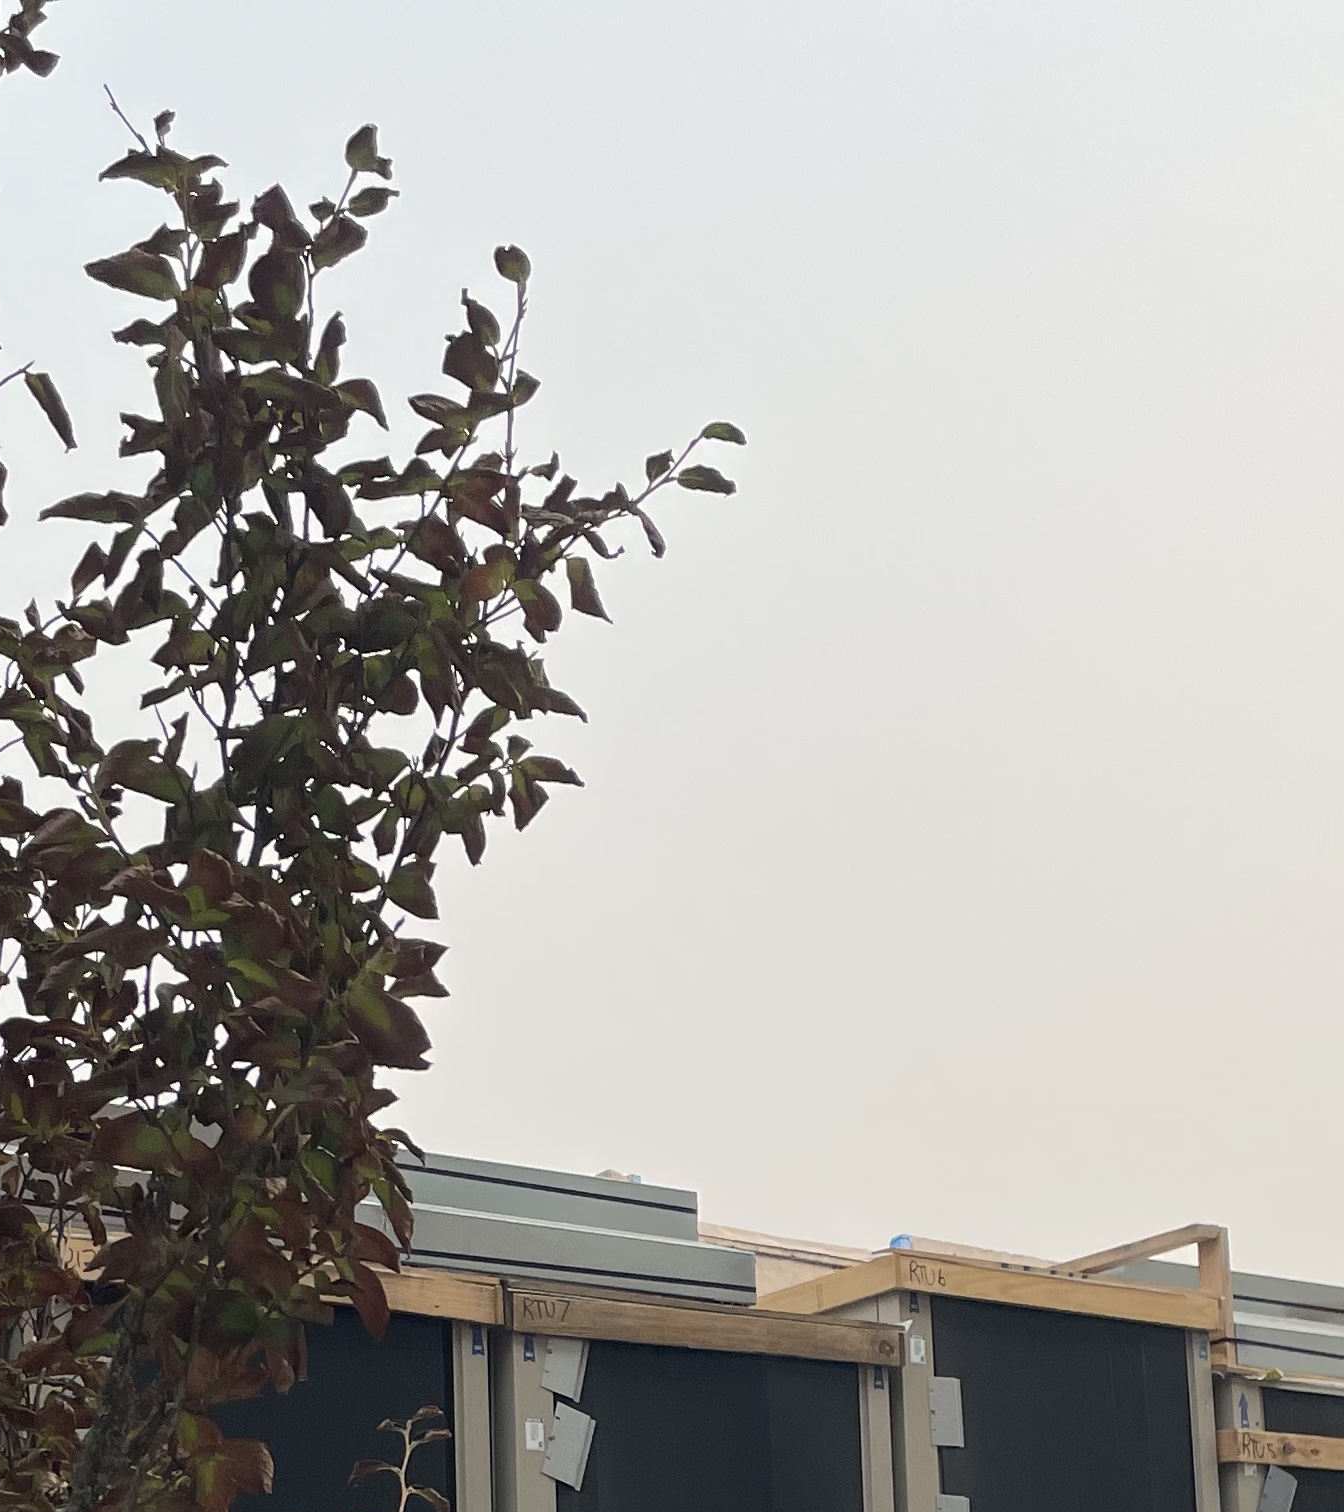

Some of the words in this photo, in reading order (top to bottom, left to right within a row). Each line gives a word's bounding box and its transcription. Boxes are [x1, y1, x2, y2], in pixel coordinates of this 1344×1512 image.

[909, 1259, 947, 1287] RTU6
[522, 1296, 571, 1323] RTU7
[1242, 1431, 1277, 1460] RTU5
